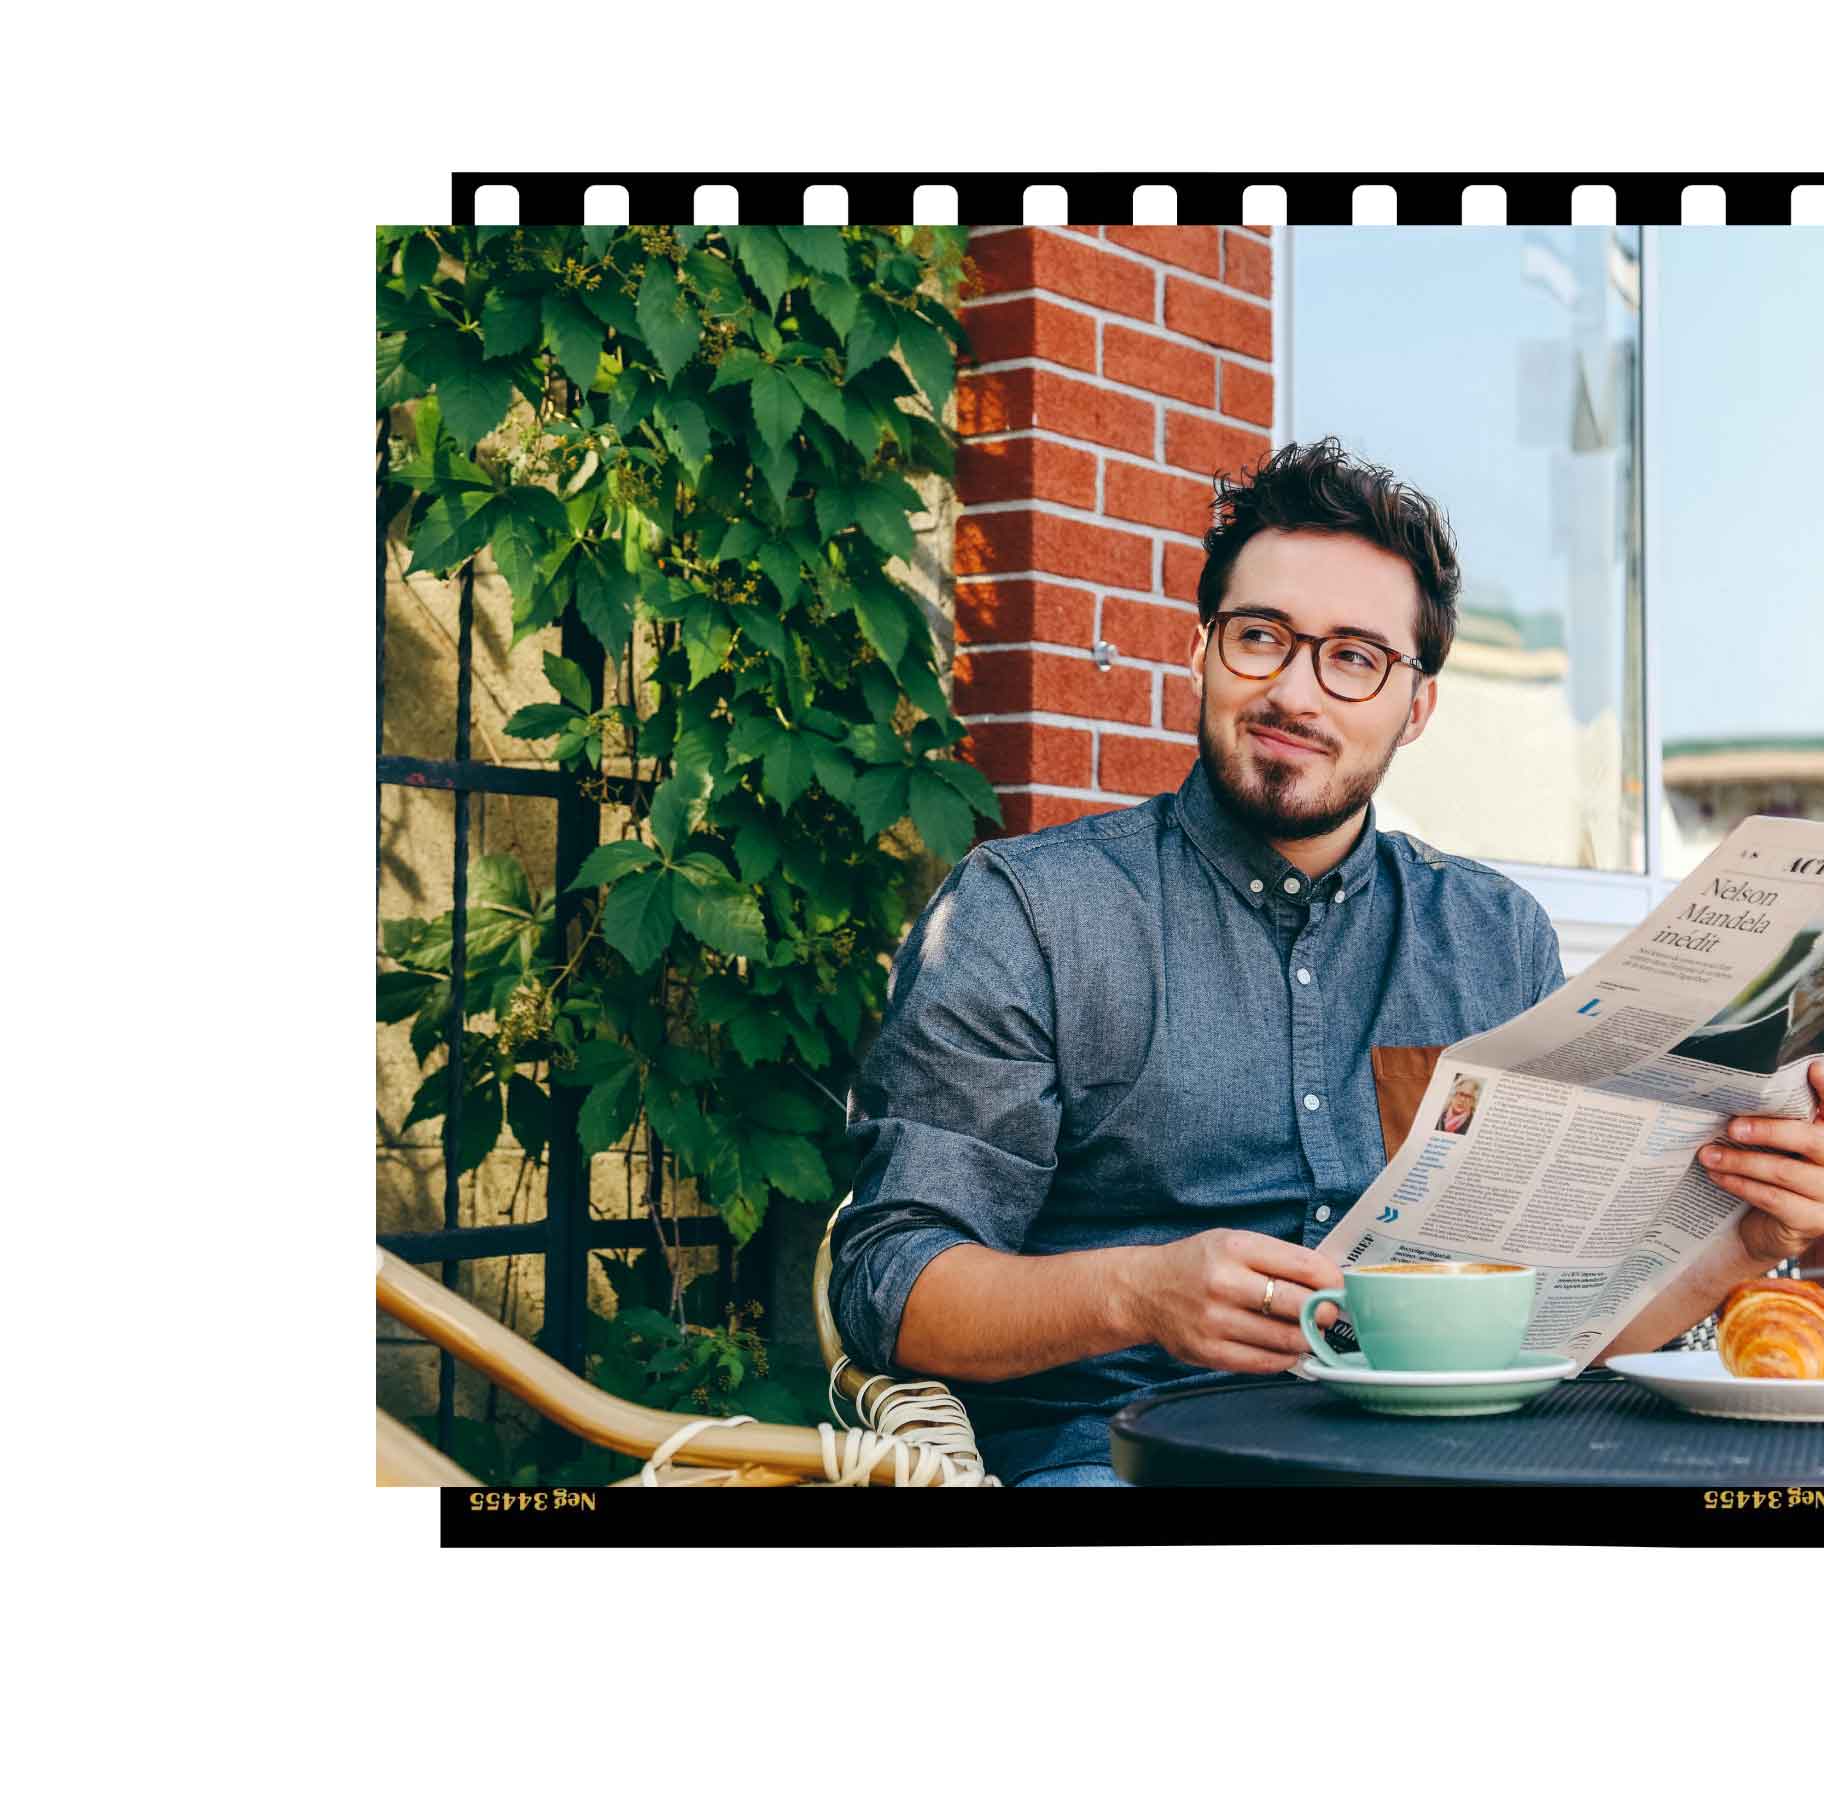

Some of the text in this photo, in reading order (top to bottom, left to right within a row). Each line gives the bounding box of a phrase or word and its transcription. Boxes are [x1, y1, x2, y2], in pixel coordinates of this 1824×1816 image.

[1701, 877, 1779, 907] Nelson
[1677, 903, 1771, 934] Mandela
[1652, 925, 1721, 953] inédit
[470, 1489, 596, 1511] Neg 34455
[1704, 1491, 1782, 1509] 34455
